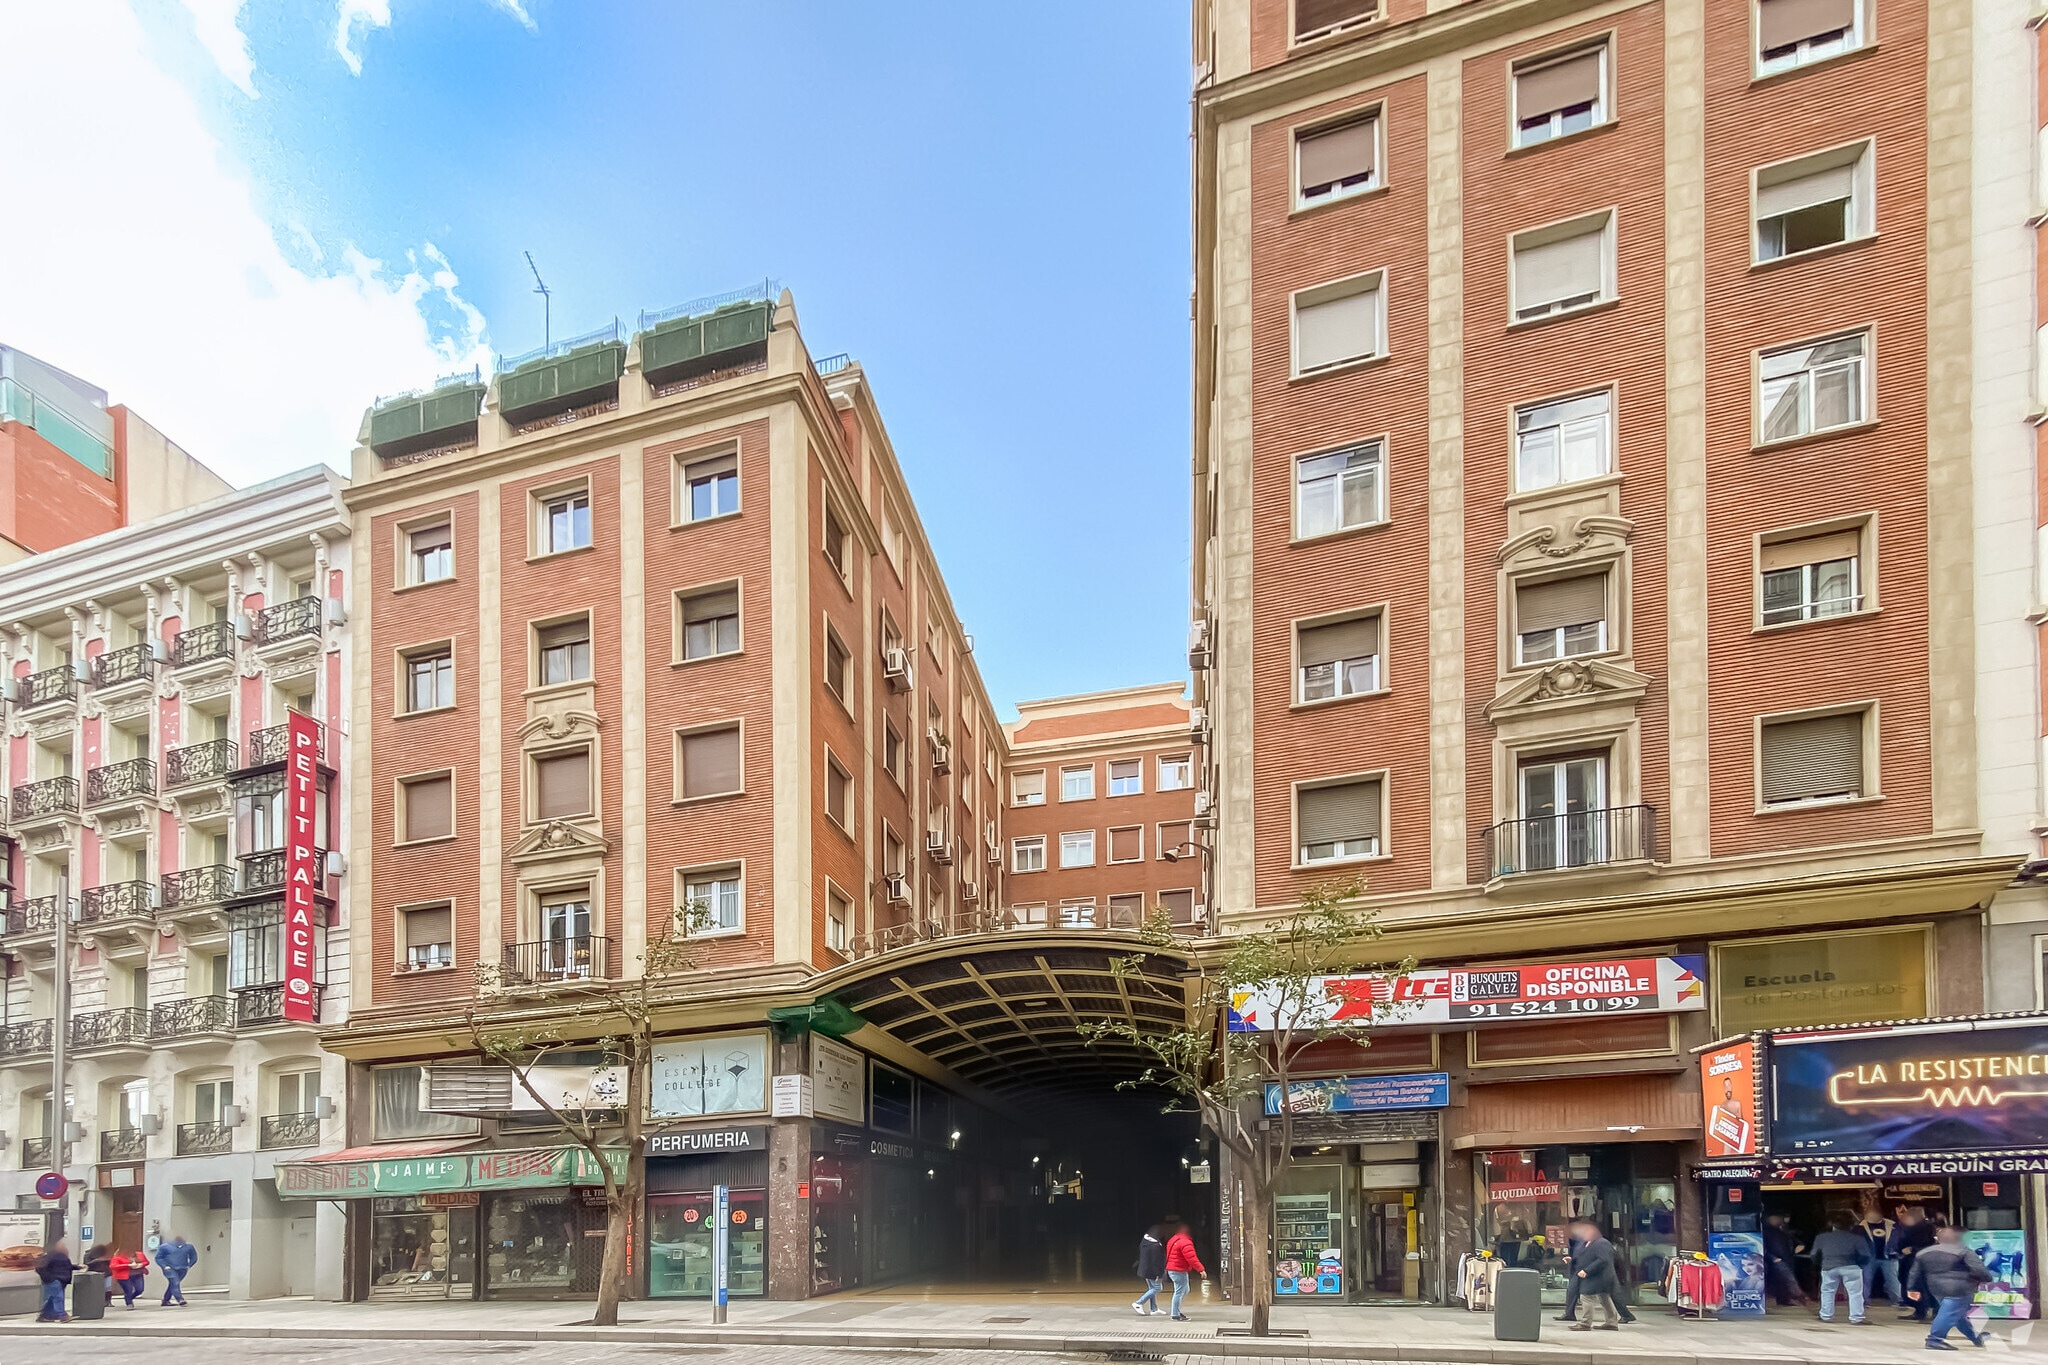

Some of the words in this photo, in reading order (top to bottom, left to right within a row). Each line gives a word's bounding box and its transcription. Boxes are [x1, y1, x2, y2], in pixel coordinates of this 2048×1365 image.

[295, 731, 311, 834] PETIT
[293, 845, 310, 968] PALACE
[1470, 972, 1518, 985] BUSQUETS
[1545, 965, 1630, 982] OFICINA
[1744, 969, 1836, 988] Escuela
[1470, 983, 1518, 995] GALVEZ
[1526, 977, 1650, 997] DISPONIBLE
[1744, 993, 1770, 1005] de
[1780, 983, 1909, 1001] Postgrados
[1469, 1003, 1500, 1017] 91
[1510, 1000, 1557, 1015] 524
[1567, 998, 1599, 1012] 10
[1607, 996, 1640, 1010] 99
[1714, 1053, 1736, 1064] Tinder
[1709, 1060, 1743, 1076] SORPRESA
[1858, 1064, 1888, 1084] LA
[664, 1079, 721, 1091] COLLEGE
[1288, 1082, 1316, 1092] ELADOS
[651, 1131, 750, 1152] PERFUMERIA
[870, 1141, 914, 1159] COSMETICA
[391, 1161, 446, 1177] JAIME
[478, 1152, 553, 1180] MEDIAS
[779, 1156, 787, 1171] 5
[1811, 1165, 1887, 1177] TEATRO
[285, 1165, 369, 1192] BOTONES
[1702, 1169, 1721, 1178] TEATRO
[1722, 1167, 1750, 1177] ARLEQUÍN
[426, 1193, 478, 1206] MEDIAS
[582, 1189, 591, 1197] EL
[1491, 1183, 1559, 1200] LIQUIDACIÓN
